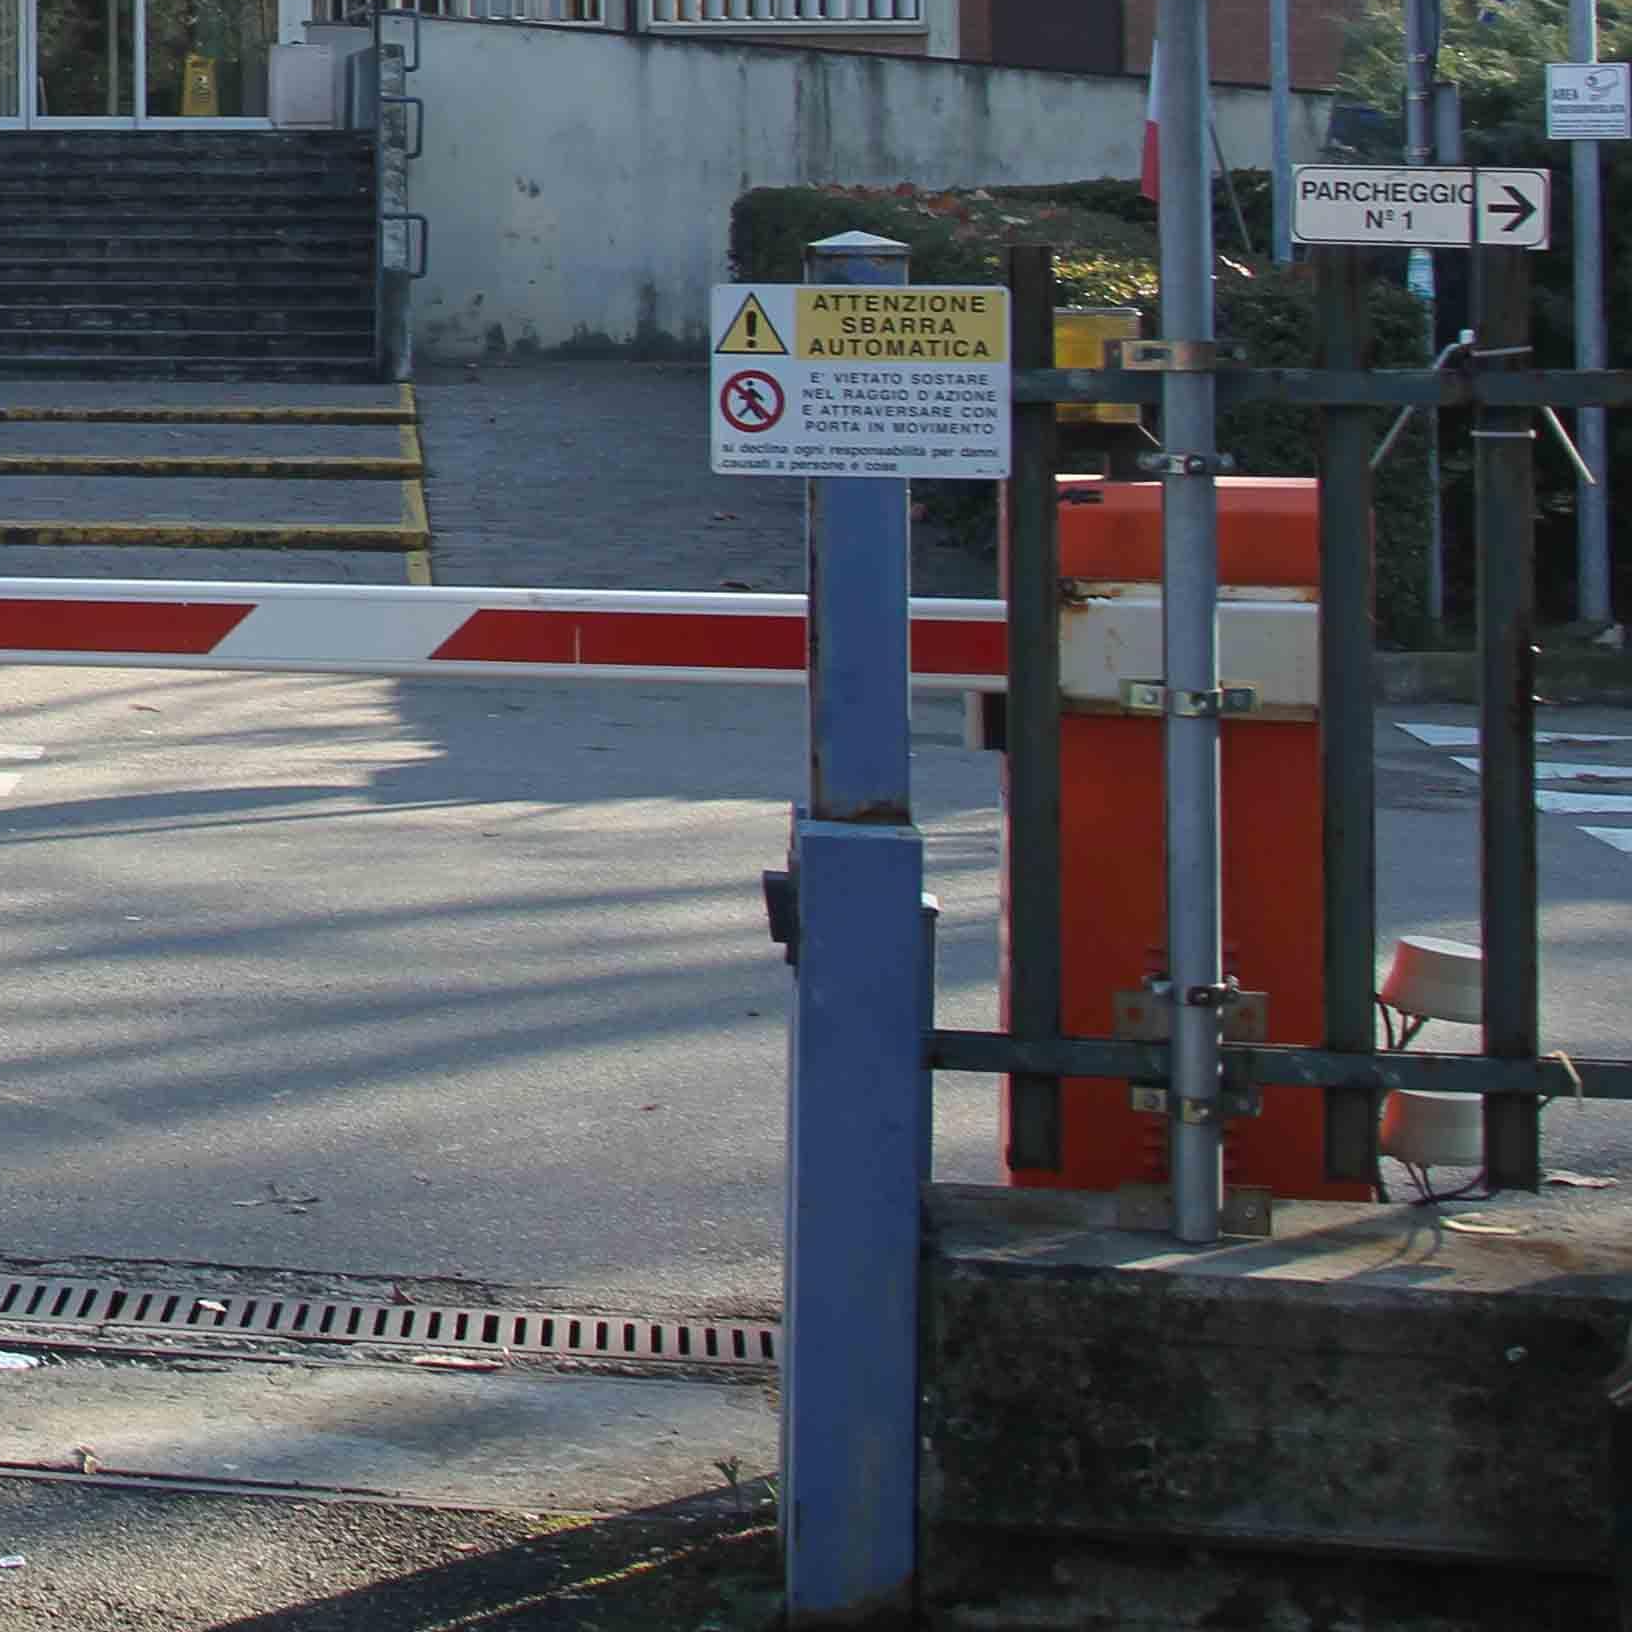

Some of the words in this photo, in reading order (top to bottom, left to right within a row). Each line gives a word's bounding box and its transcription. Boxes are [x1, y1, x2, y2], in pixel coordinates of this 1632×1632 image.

[812, 294, 987, 314] ATTENZIONE
[841, 316, 957, 335] SBARRA
[808, 338, 991, 358] AUTOMATICA
[834, 371, 903, 385] VIETATO
[910, 372, 990, 386] SOSTARE
[802, 388, 835, 401] NEL
[842, 388, 910, 402] RAGGIO
[802, 404, 813, 416] E
[819, 404, 953, 418] ATTRAVERSARE
[961, 405, 998, 419] CON
[805, 420, 861, 433] PORTA
[868, 422, 885, 434] IN
[893, 422, 996, 435] MOVIMENTO
[738, 443, 788, 455] declina
[793, 444, 824, 457] ogni
[931, 447, 955, 459] per
[789, 460, 846, 472] persone
